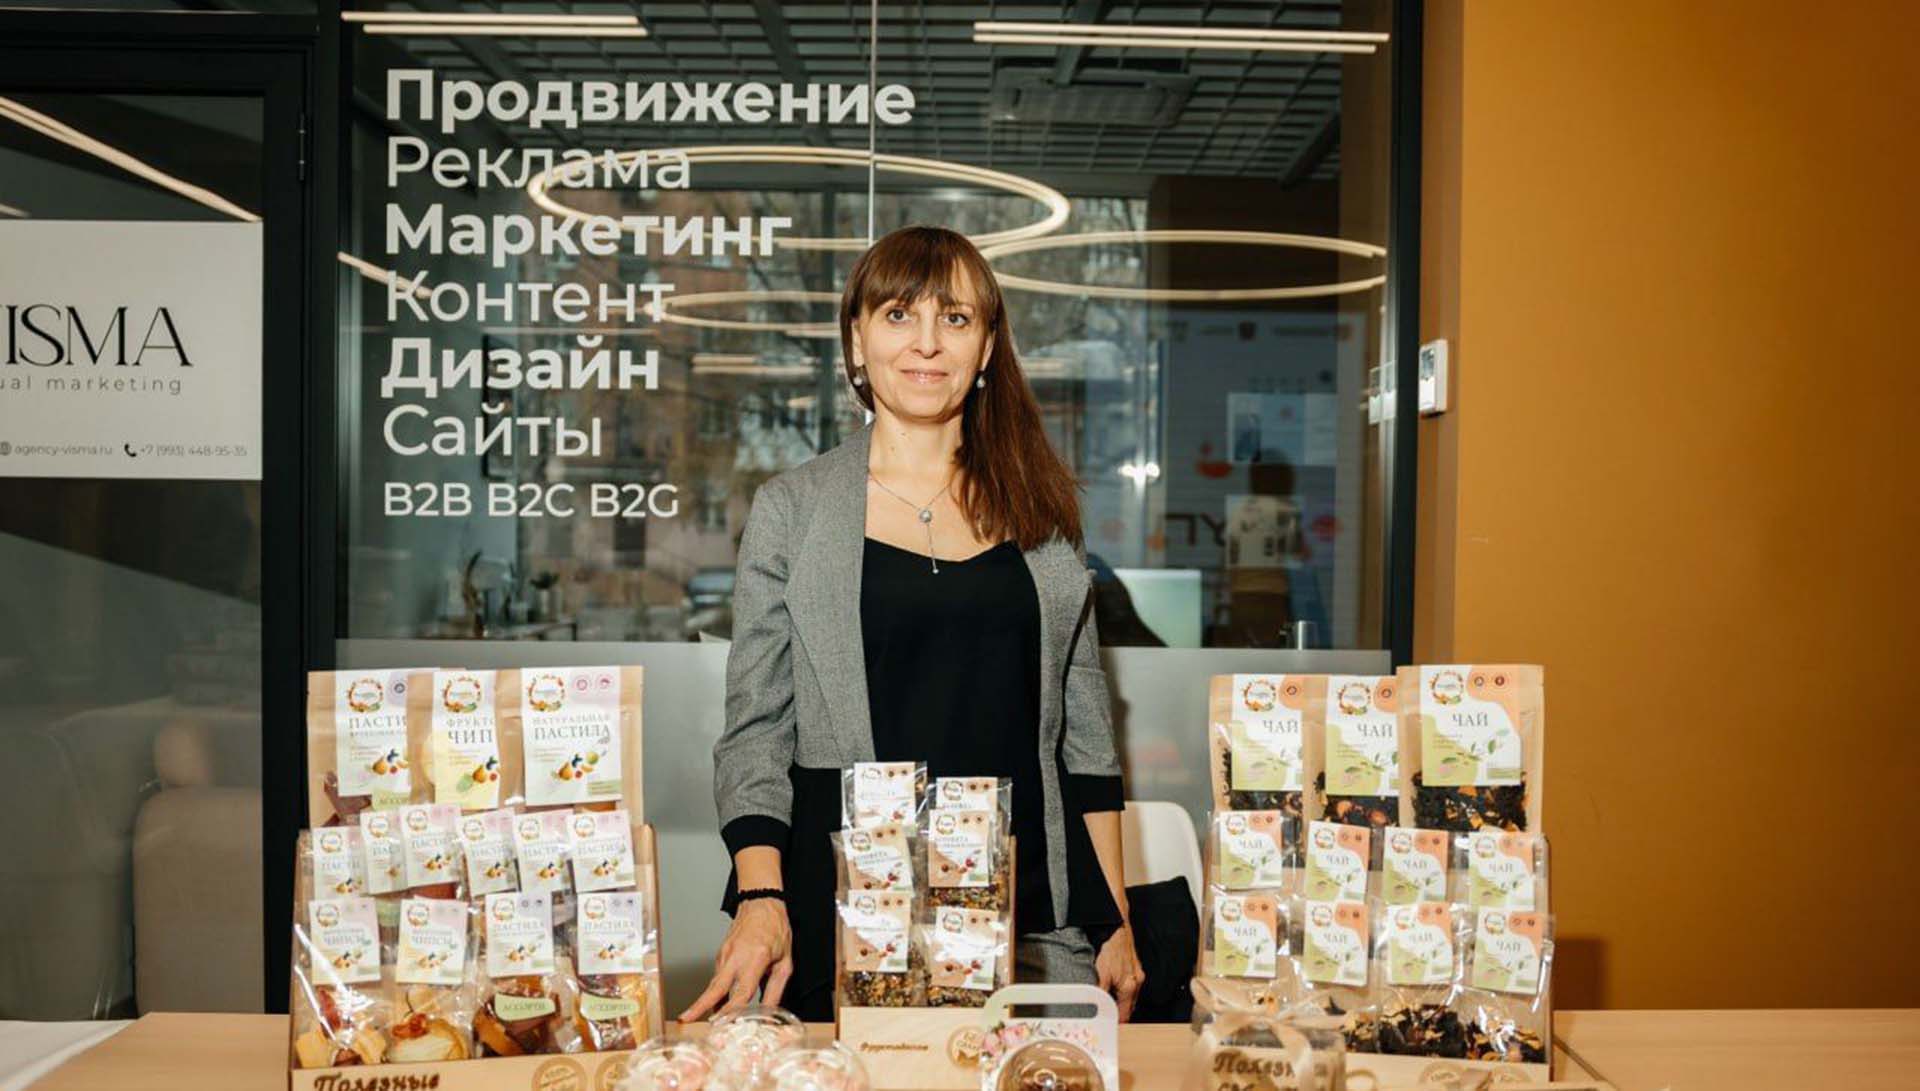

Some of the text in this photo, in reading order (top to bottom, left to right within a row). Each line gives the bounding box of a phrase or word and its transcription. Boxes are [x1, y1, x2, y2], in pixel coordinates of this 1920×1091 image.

[385, 69, 917, 127] Продвижение
[387, 137, 692, 190] Реклама
[385, 204, 793, 266] Маркетинг
[387, 271, 675, 323] Контент
[0, 303, 193, 367] ISMA
[381, 336, 660, 398] Дизайн
[47, 376, 182, 395] marketing
[382, 404, 602, 459] Сайты
[14, 443, 113, 456] agency-visma.ru
[384, 483, 680, 519] B2B B2C B2G
[1262, 718, 1299, 734] ЧАЙ
[1451, 712, 1489, 727] ЧАЙ
[534, 724, 610, 740] ПАСТИЛА
[1357, 722, 1393, 738] ЧАЙ
[1238, 838, 1263, 849] ЧАЙ
[1325, 853, 1350, 866] ЧАЙ
[1403, 858, 1428, 870] ЧАЙ
[1488, 862, 1514, 874] ЧАЙ
[1233, 926, 1258, 938] ЧАЙ
[1323, 932, 1348, 945] ЧАЙ
[1408, 931, 1433, 943] ЧАЙ
[1496, 939, 1521, 952] ЧАЙ
